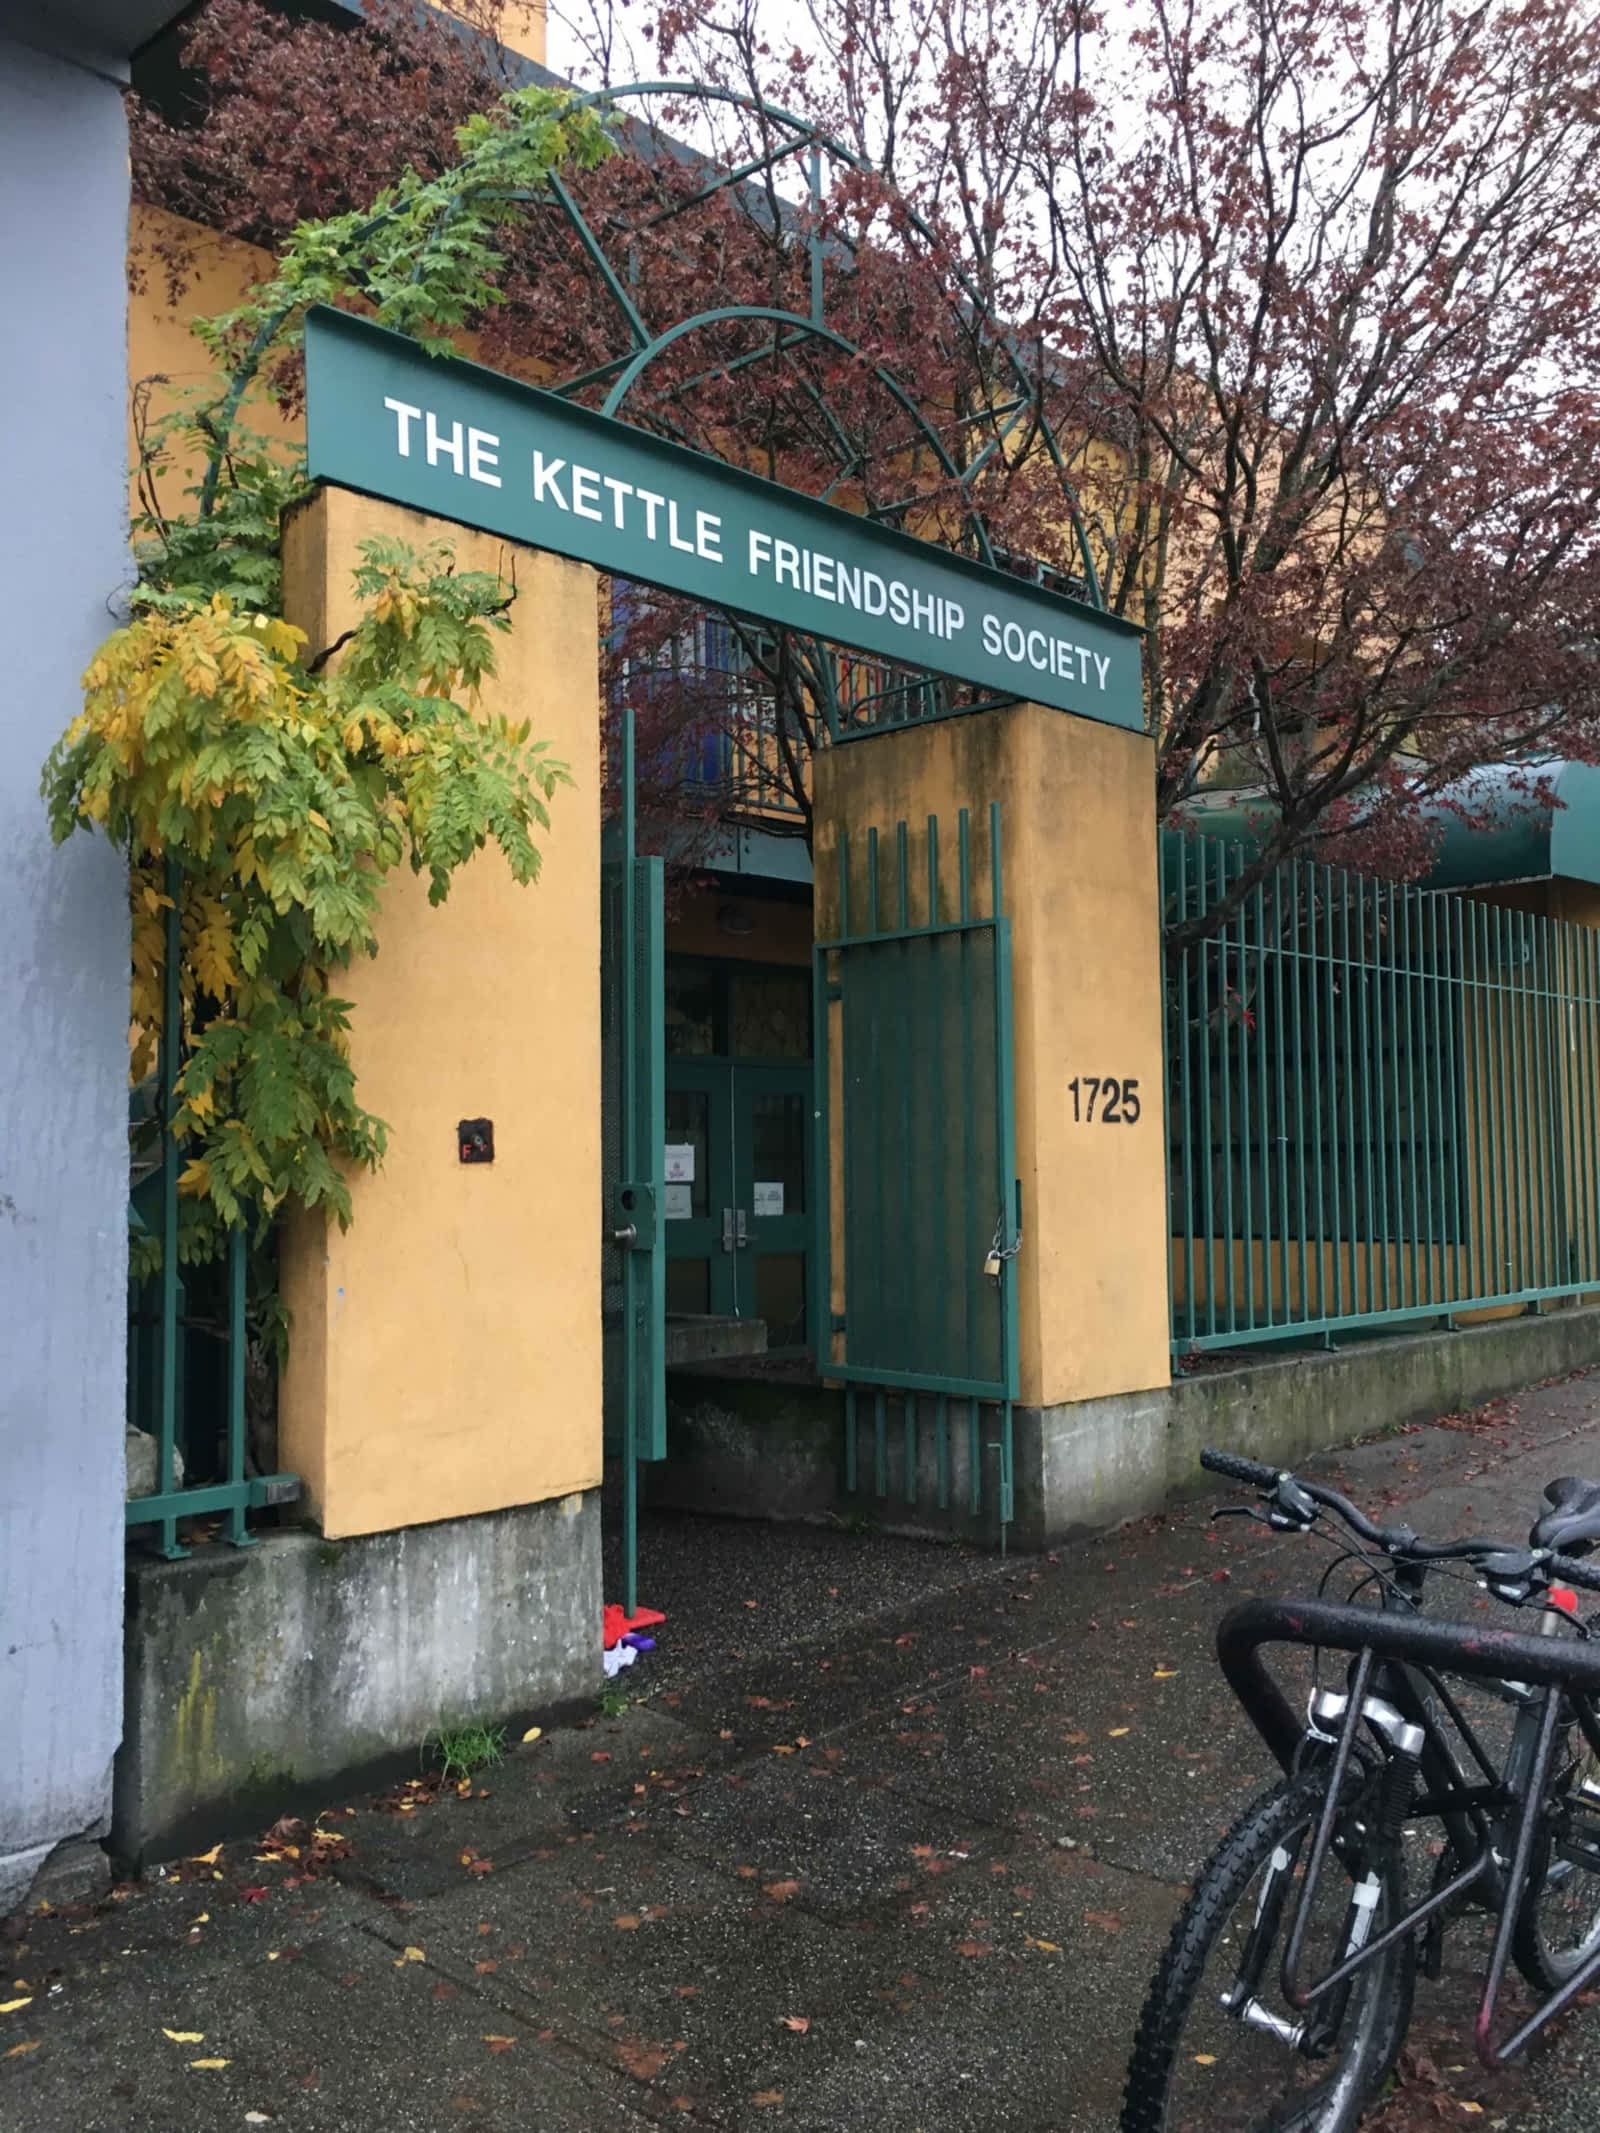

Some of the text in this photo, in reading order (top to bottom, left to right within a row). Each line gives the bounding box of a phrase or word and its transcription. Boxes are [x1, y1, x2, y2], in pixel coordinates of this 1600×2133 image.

[384, 396, 1111, 690] THE KETTLE FRIENDSHIP SOCIETY
[1068, 1077, 1140, 1124] 1725
